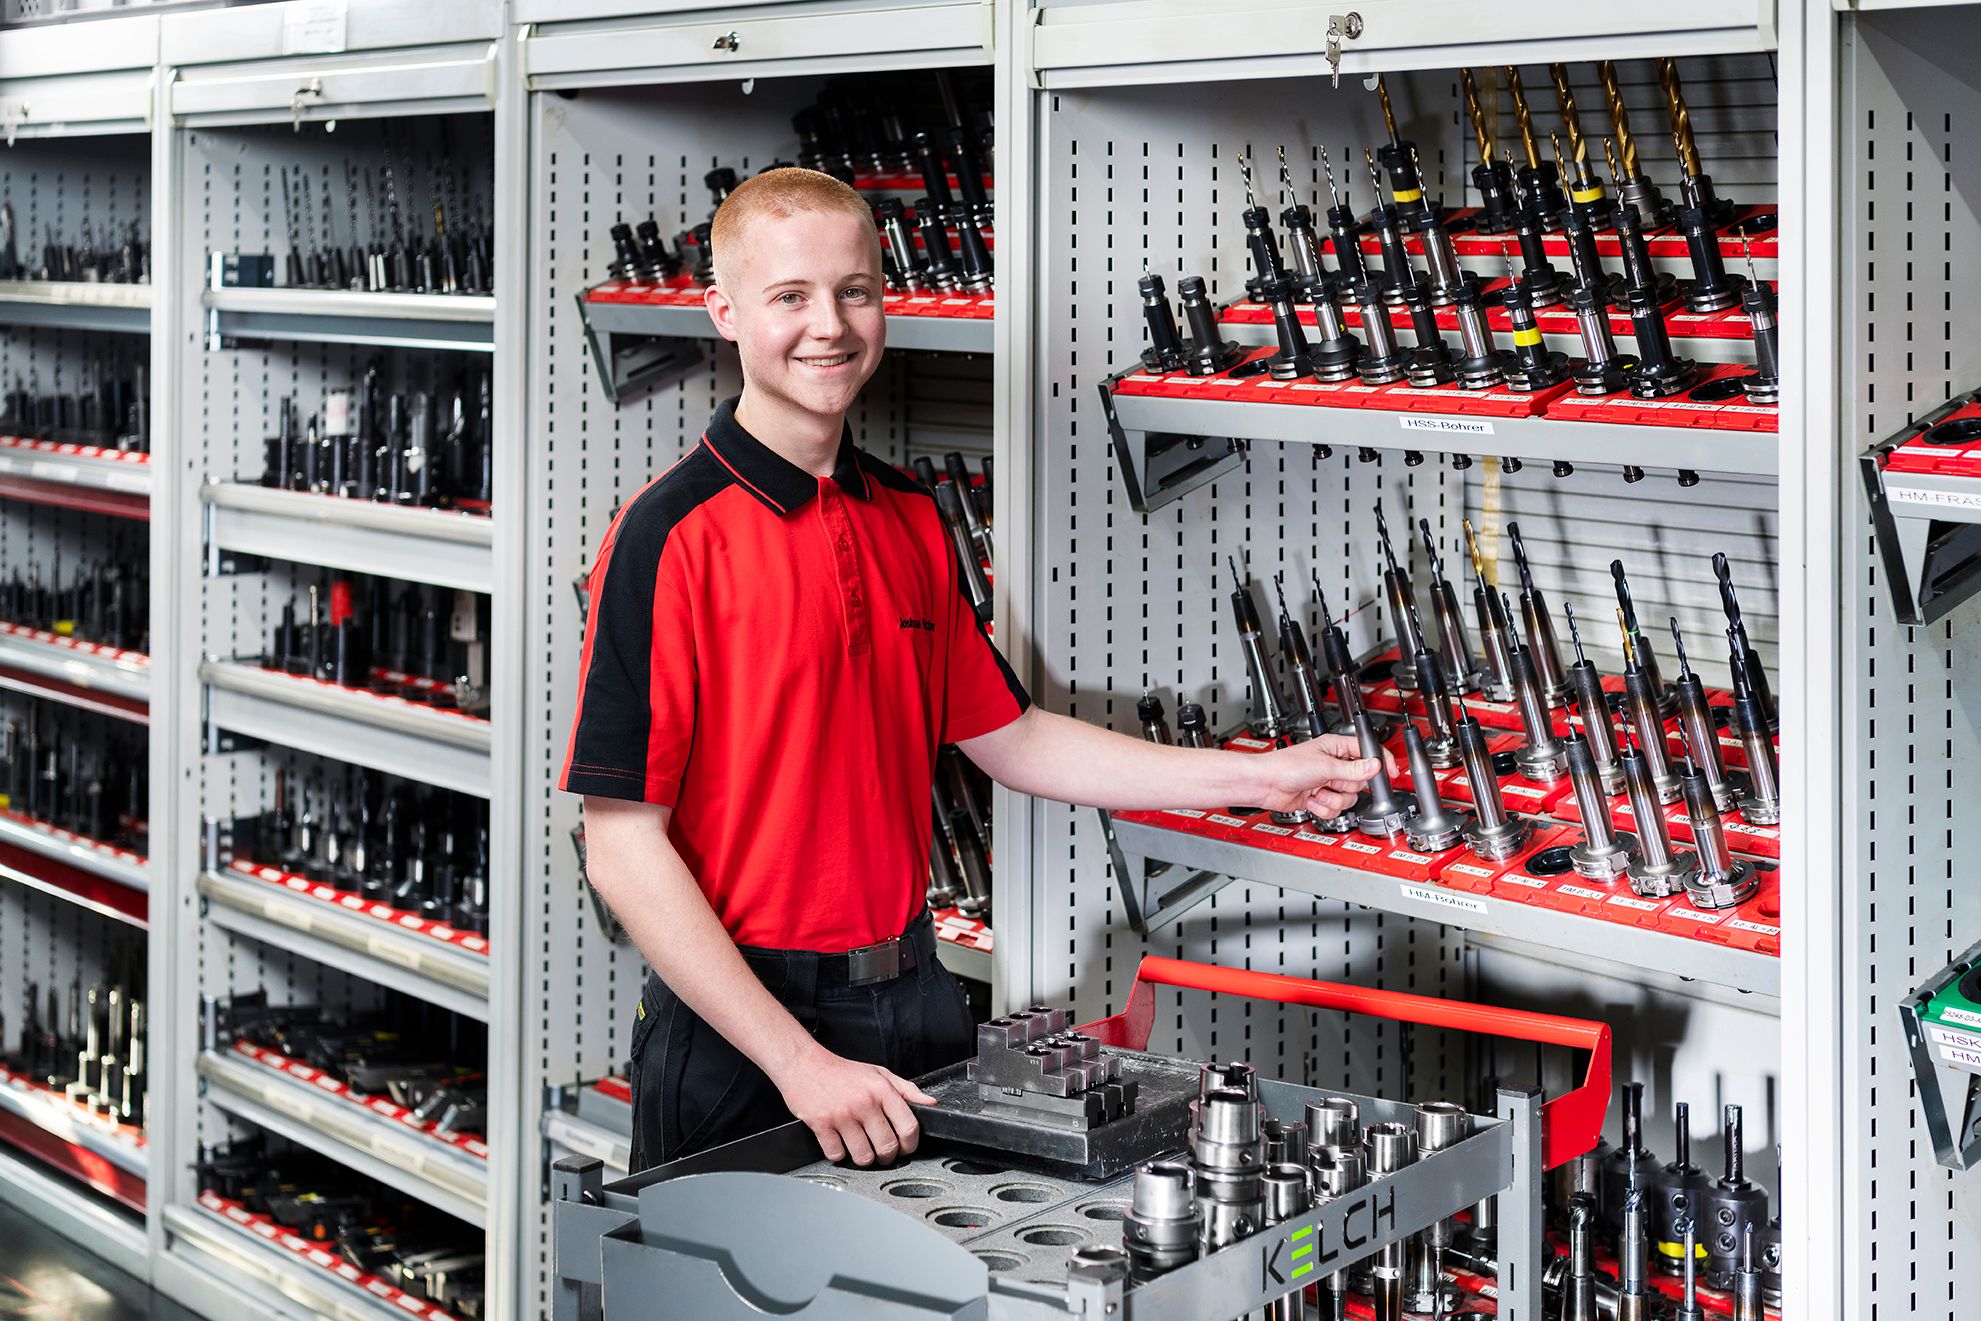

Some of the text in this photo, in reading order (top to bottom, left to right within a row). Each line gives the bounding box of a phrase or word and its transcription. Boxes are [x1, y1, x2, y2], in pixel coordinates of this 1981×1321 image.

[1407, 419, 1484, 432] HSS-Bohrer
[1409, 889, 1478, 909] HM-Bohrer
[1262, 1186, 1395, 1295] KELCH
